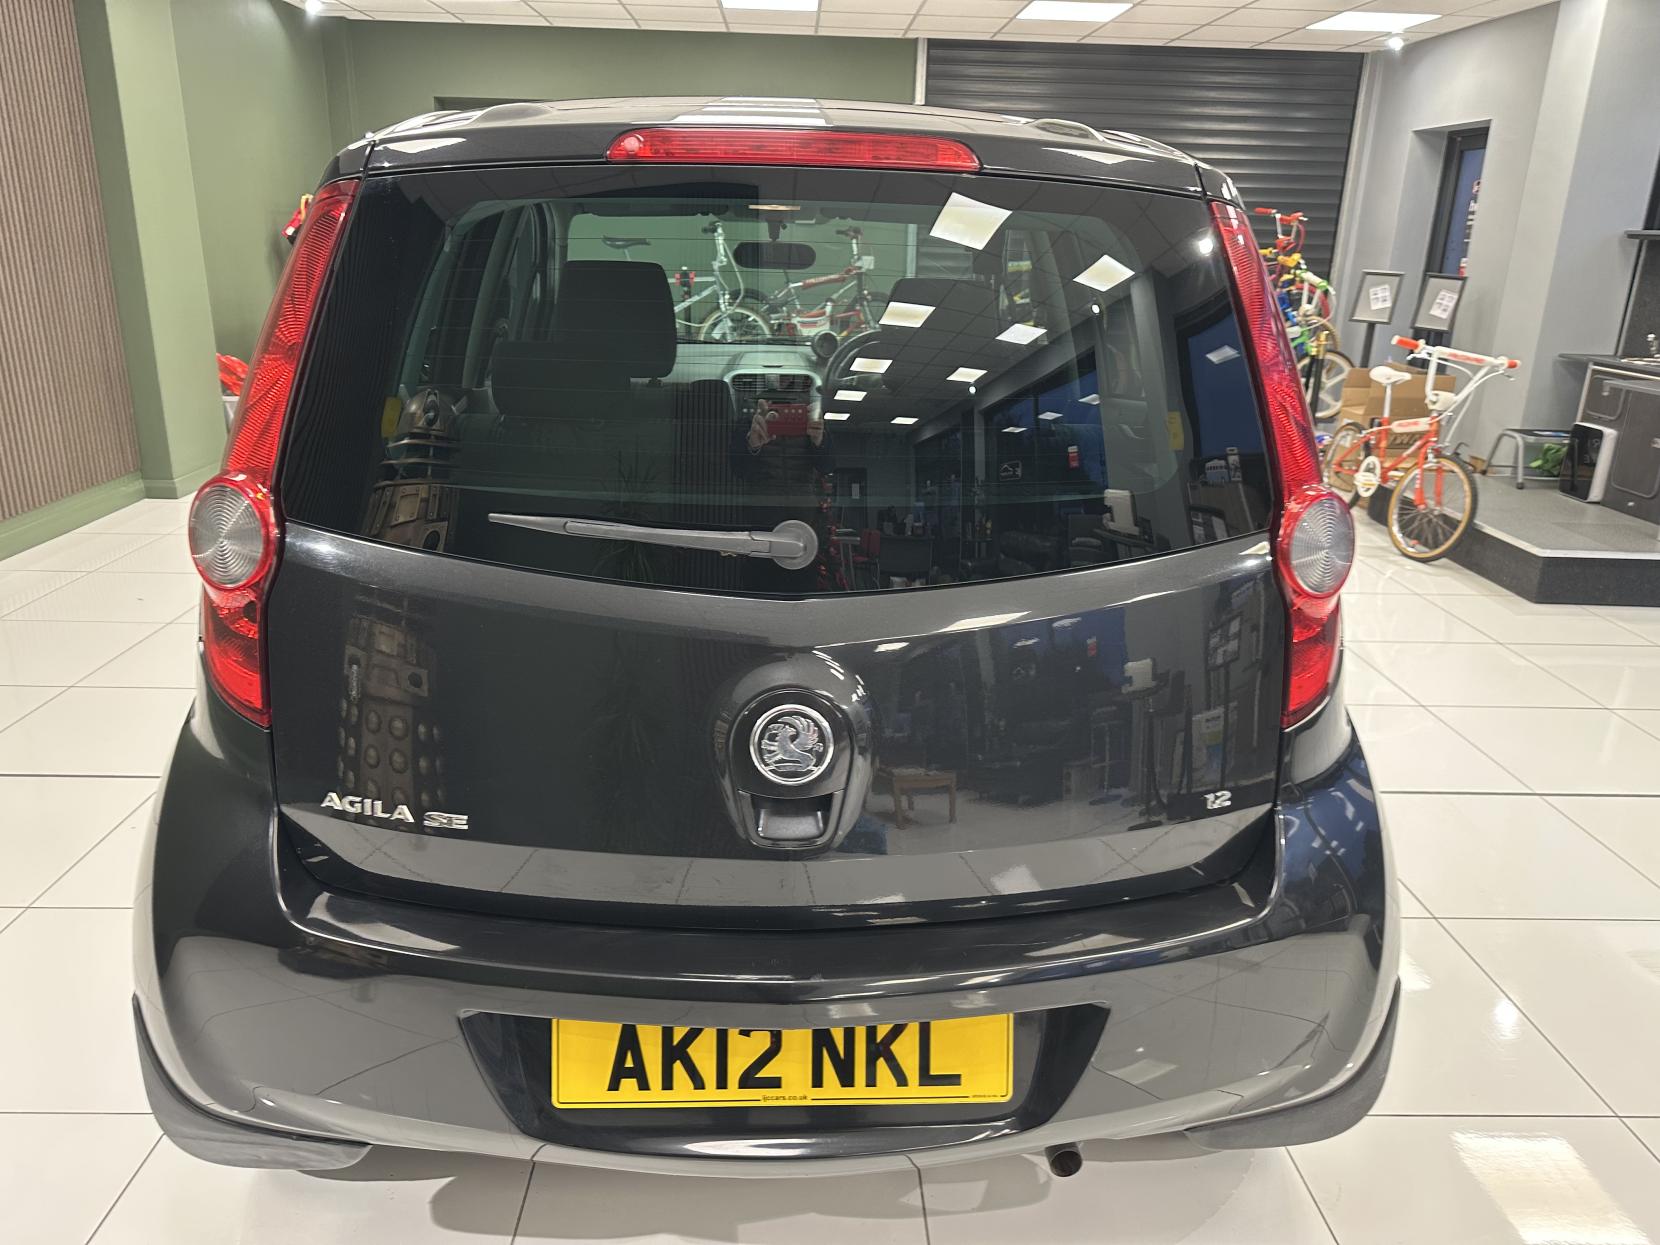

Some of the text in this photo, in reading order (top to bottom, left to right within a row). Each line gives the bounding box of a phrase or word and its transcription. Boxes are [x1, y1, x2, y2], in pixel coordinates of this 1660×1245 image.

[320, 791, 469, 830] AGILA SE
[606, 1021, 962, 1092] AK12 NKL
